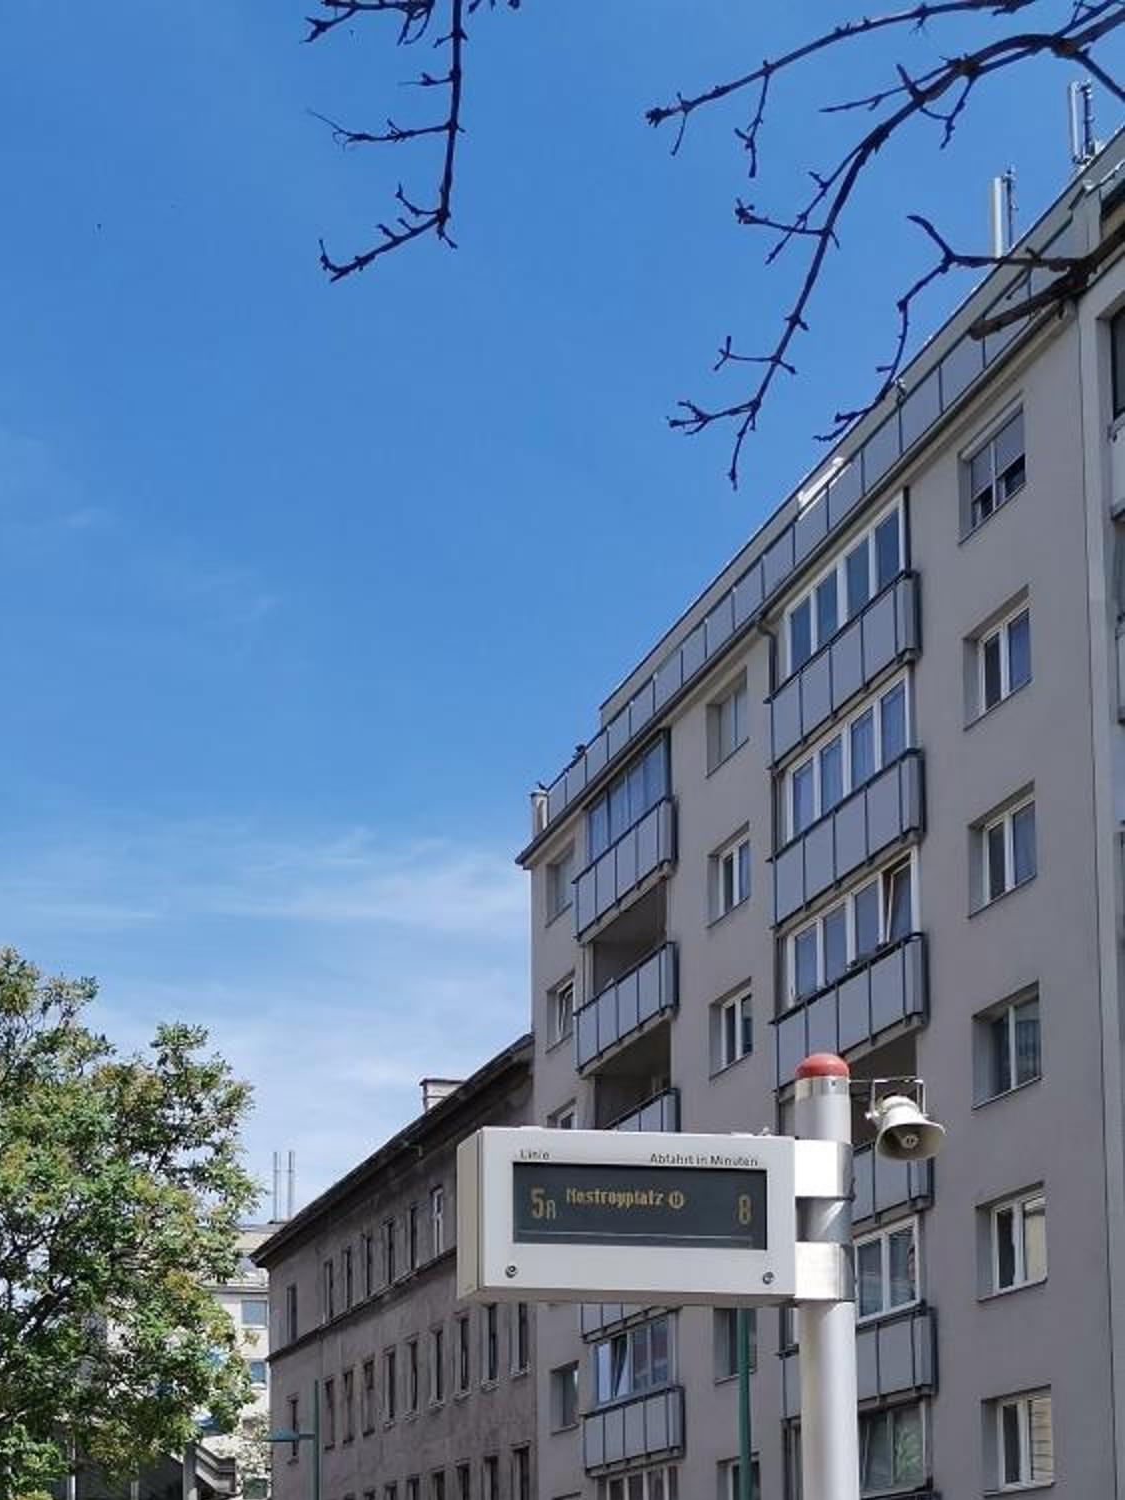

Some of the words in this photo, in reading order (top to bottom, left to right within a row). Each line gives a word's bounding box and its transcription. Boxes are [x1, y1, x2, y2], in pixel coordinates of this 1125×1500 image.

[520, 1149, 550, 1160] Linie
[650, 1152, 694, 1165] Abfahrt
[696, 1154, 707, 1165] in
[710, 1155, 759, 1167] Minuten
[738, 1194, 752, 1225] 8
